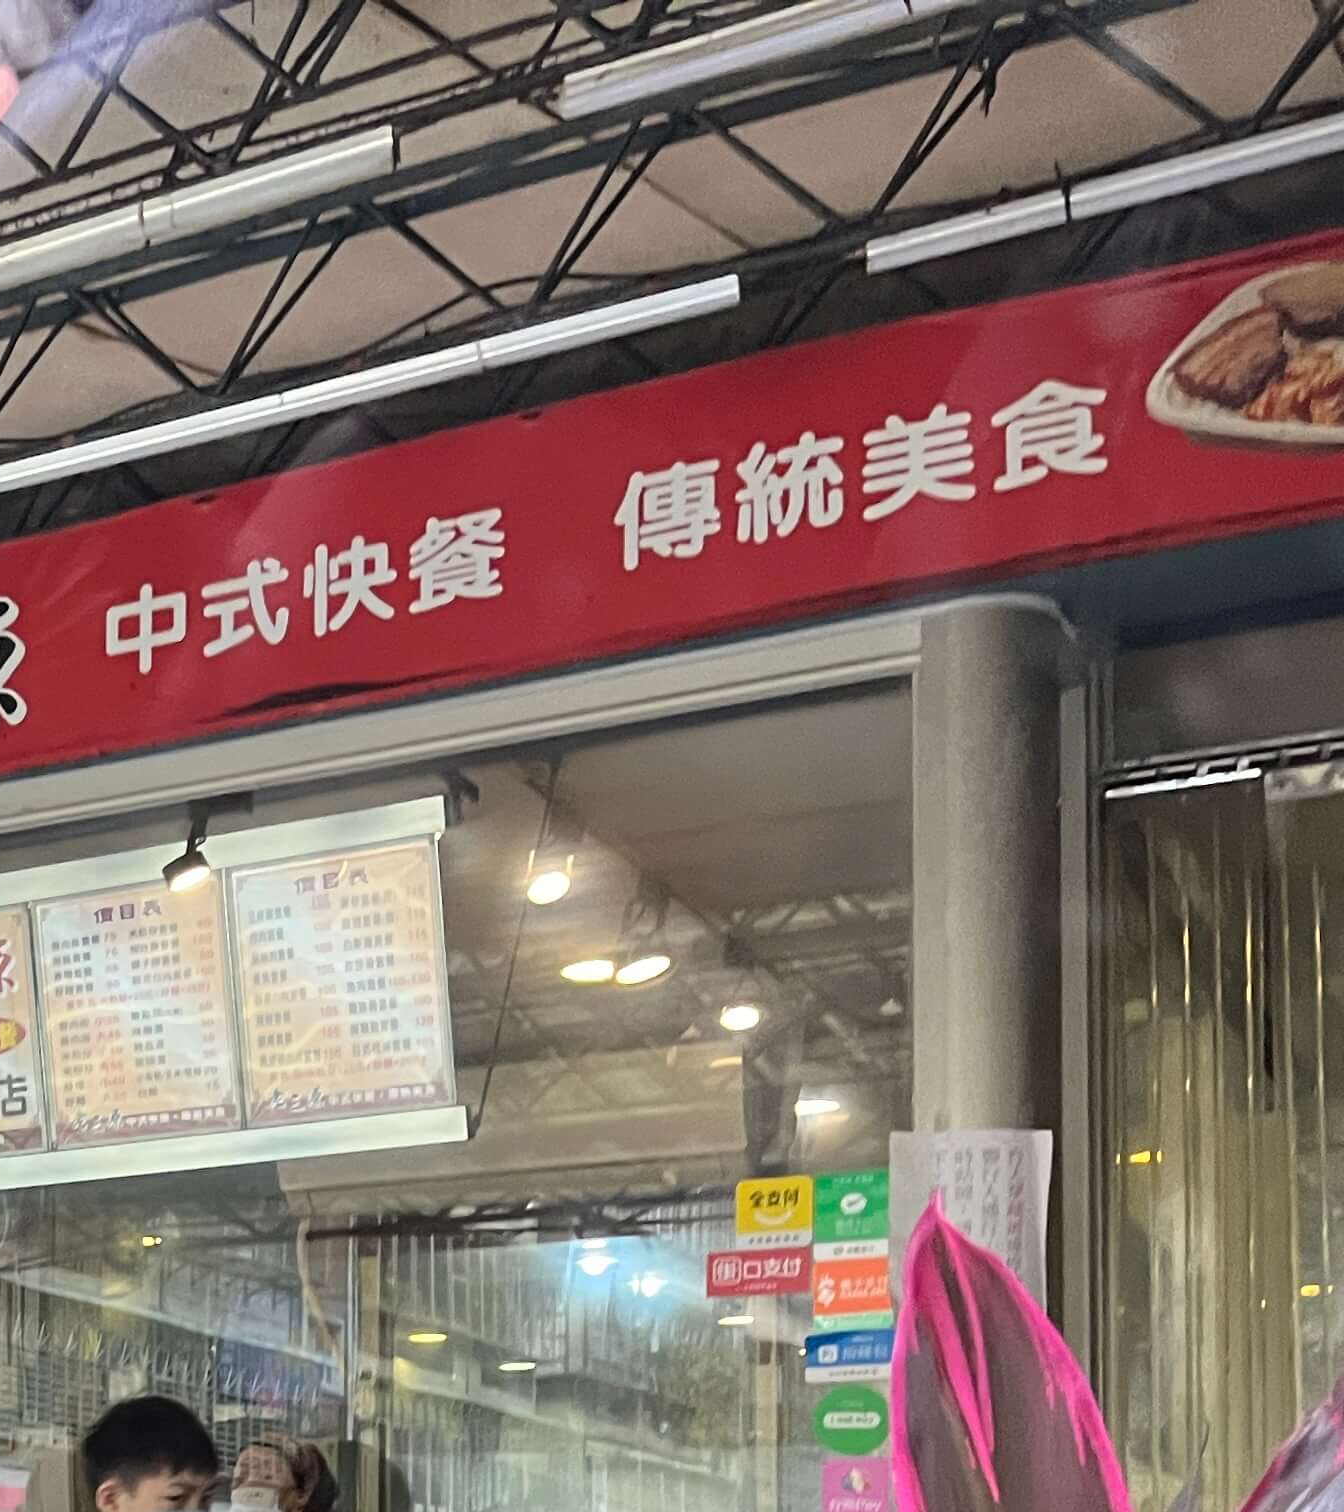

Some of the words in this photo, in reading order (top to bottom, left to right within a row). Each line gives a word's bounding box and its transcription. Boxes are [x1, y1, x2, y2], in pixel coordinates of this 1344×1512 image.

[106, 507, 505, 675] 中式快餐
[614, 379, 1108, 570] 傳統美食
